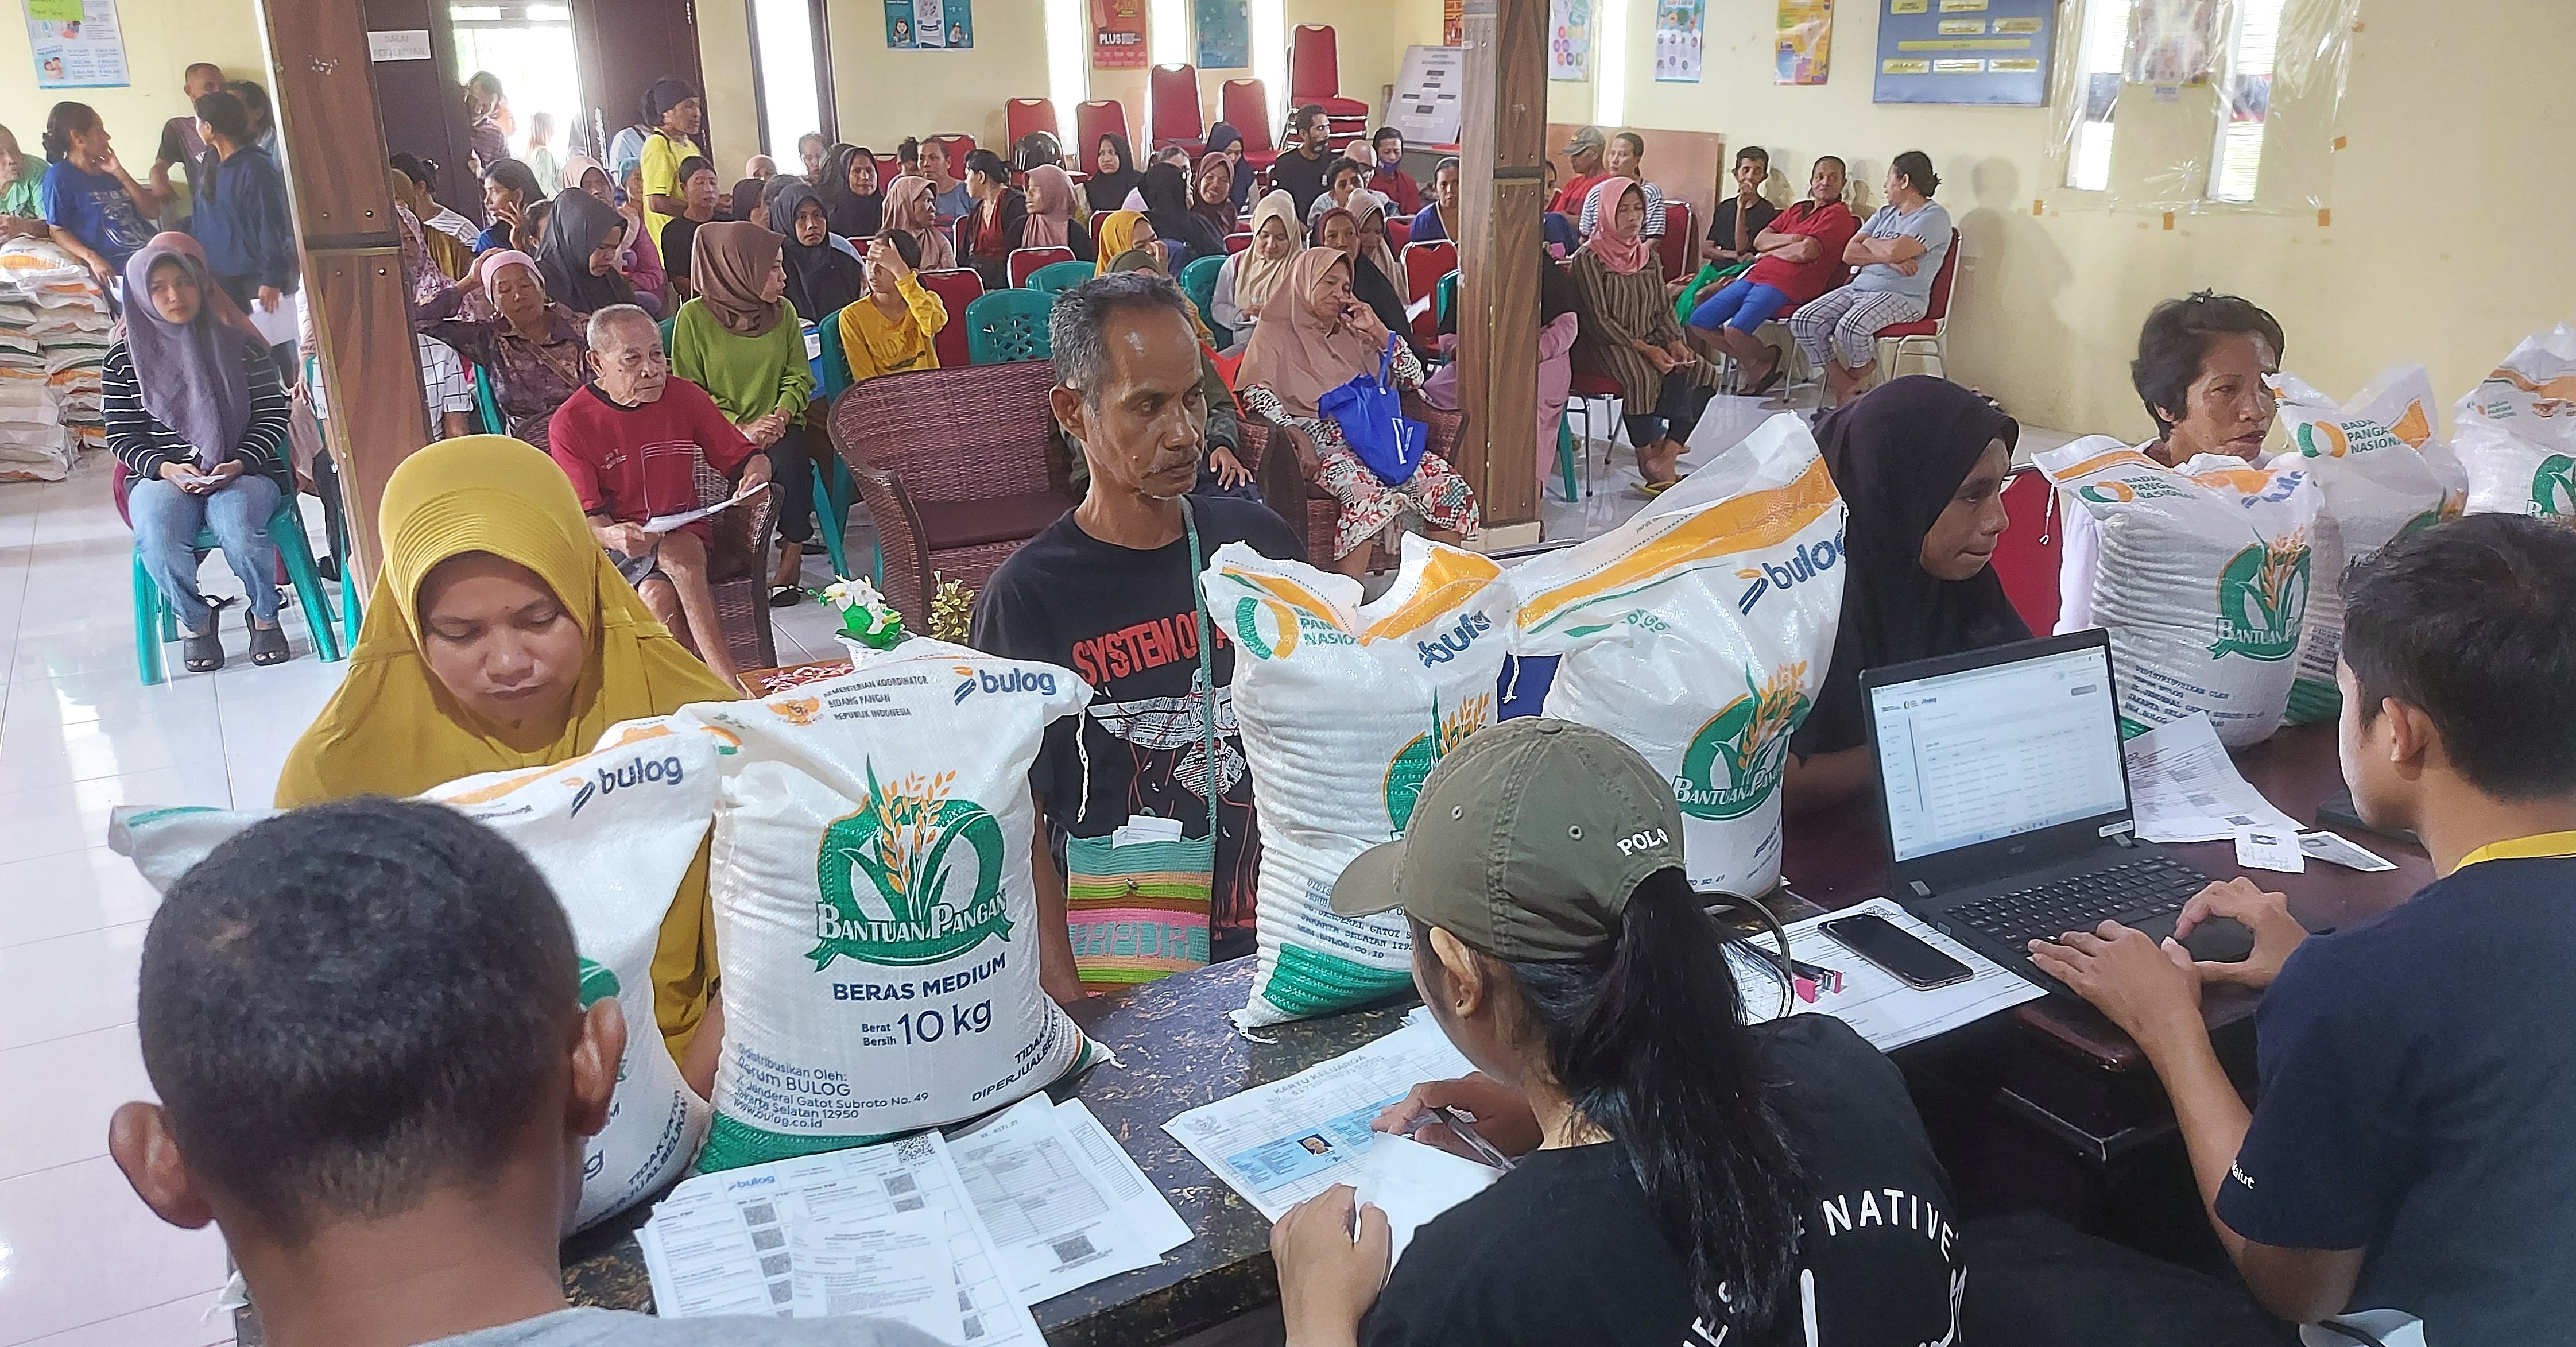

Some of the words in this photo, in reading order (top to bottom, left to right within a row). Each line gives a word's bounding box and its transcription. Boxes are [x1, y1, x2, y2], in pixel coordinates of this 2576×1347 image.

[1099, 33, 1122, 45] PLUS
[1072, 618, 1179, 686] SYSTEM
[877, 675, 928, 688] KOORDINATOR
[979, 667, 1057, 696] bulog
[827, 696, 859, 709] BIDANG
[861, 694, 891, 705] PANGAN
[598, 756, 684, 794] bulog
[1672, 775, 1747, 806] BANTUAN
[1616, 827, 1669, 857] POLO
[816, 901, 926, 943] BANTUAN
[930, 890, 1007, 940] PANGAN
[1370, 924, 1401, 938] GATOT
[833, 983, 915, 1001] BERAS
[923, 951, 1006, 998] MEDIUM
[862, 1023, 892, 1033] Berat
[897, 1009, 944, 1046] 10
[952, 998, 991, 1036] kg
[863, 1036, 897, 1047] Bersih
[813, 1068, 847, 1082] Oleh:
[786, 1075, 851, 1097] BULOG
[1273, 1078, 1310, 1095] KARTU
[796, 1095, 833, 1109] Gatot
[835, 1097, 888, 1109] Subroto
[890, 1096, 911, 1106] No.
[913, 1091, 929, 1102] 49
[773, 1102, 819, 1120] Selatan
[822, 1109, 859, 1120] 12950
[737, 1175, 776, 1189] bulog
